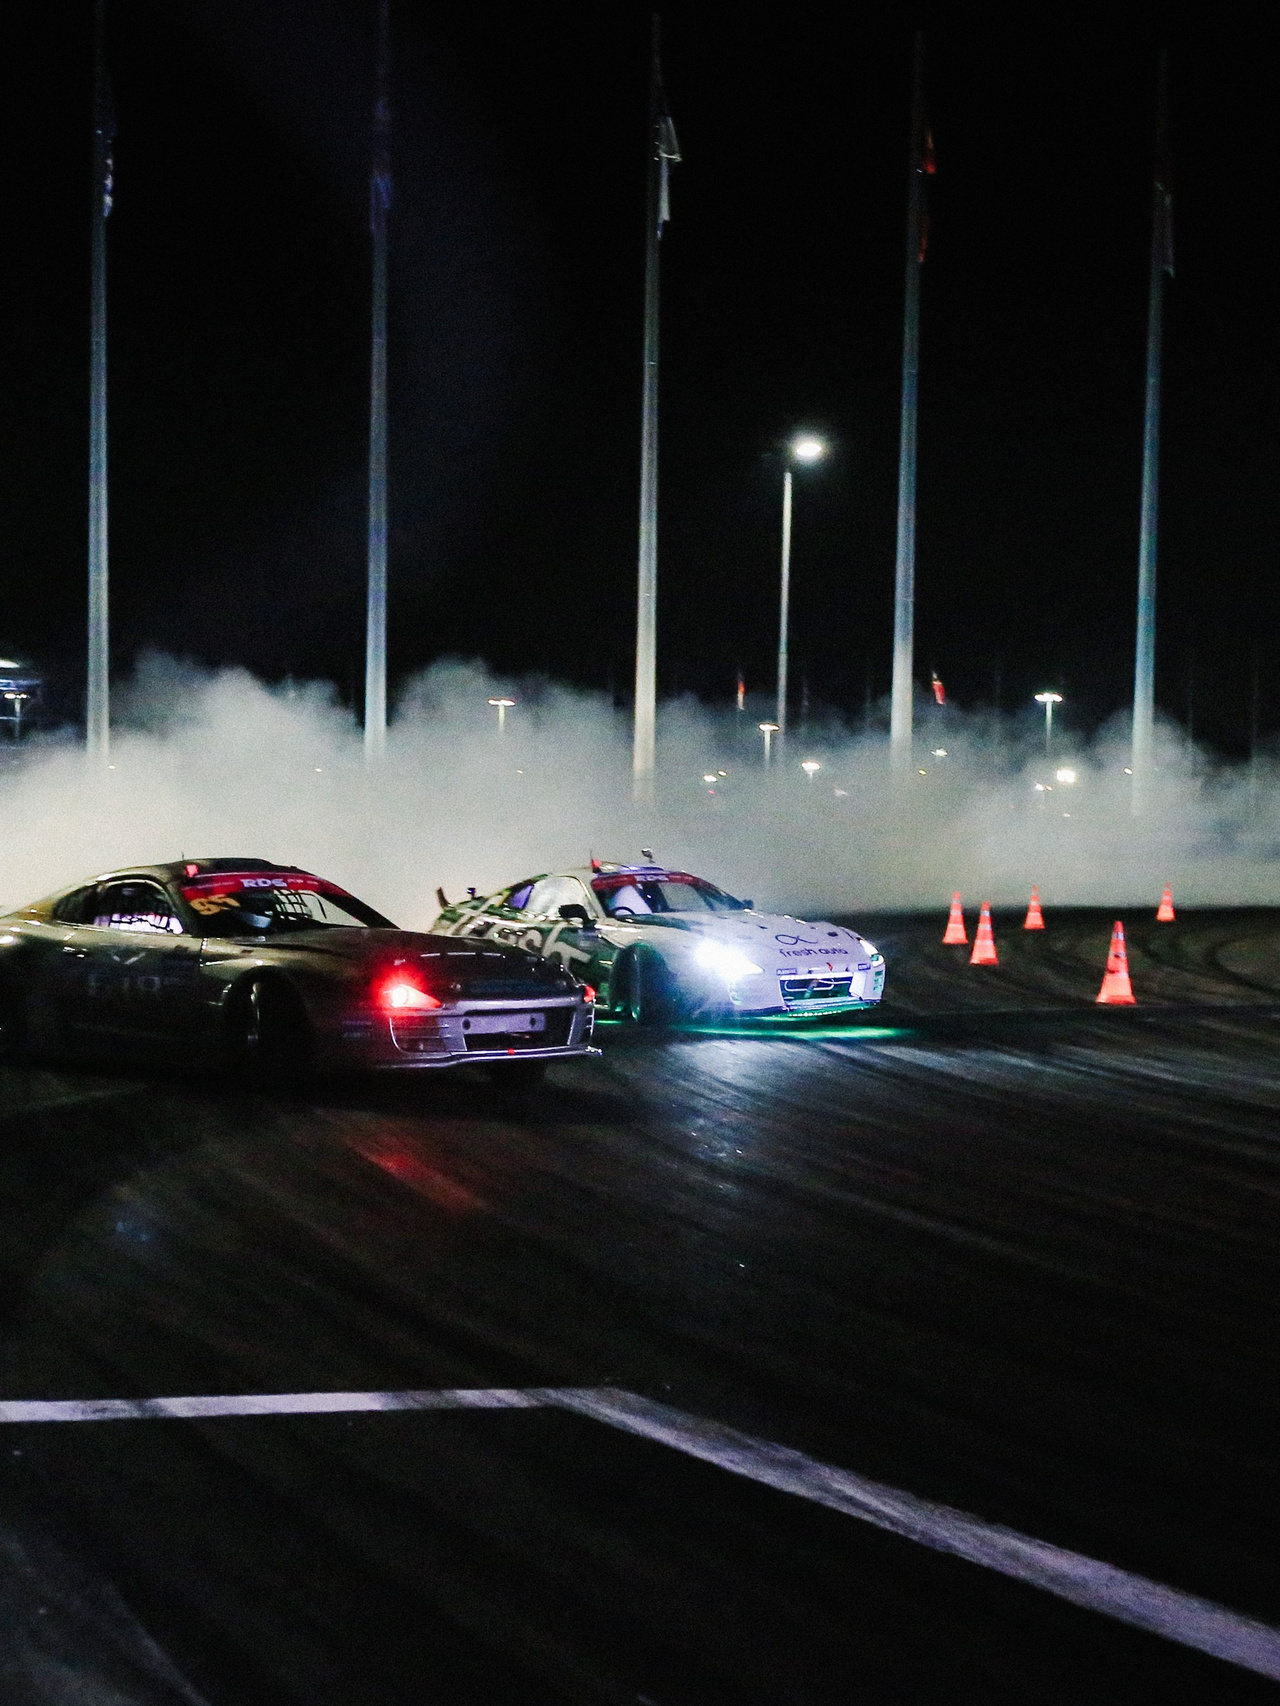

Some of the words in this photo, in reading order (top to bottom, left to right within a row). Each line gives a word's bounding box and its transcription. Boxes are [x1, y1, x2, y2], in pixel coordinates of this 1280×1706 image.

[240, 878, 287, 888] RDS
[779, 947, 818, 958] fresh
[818, 947, 849, 955] auto
